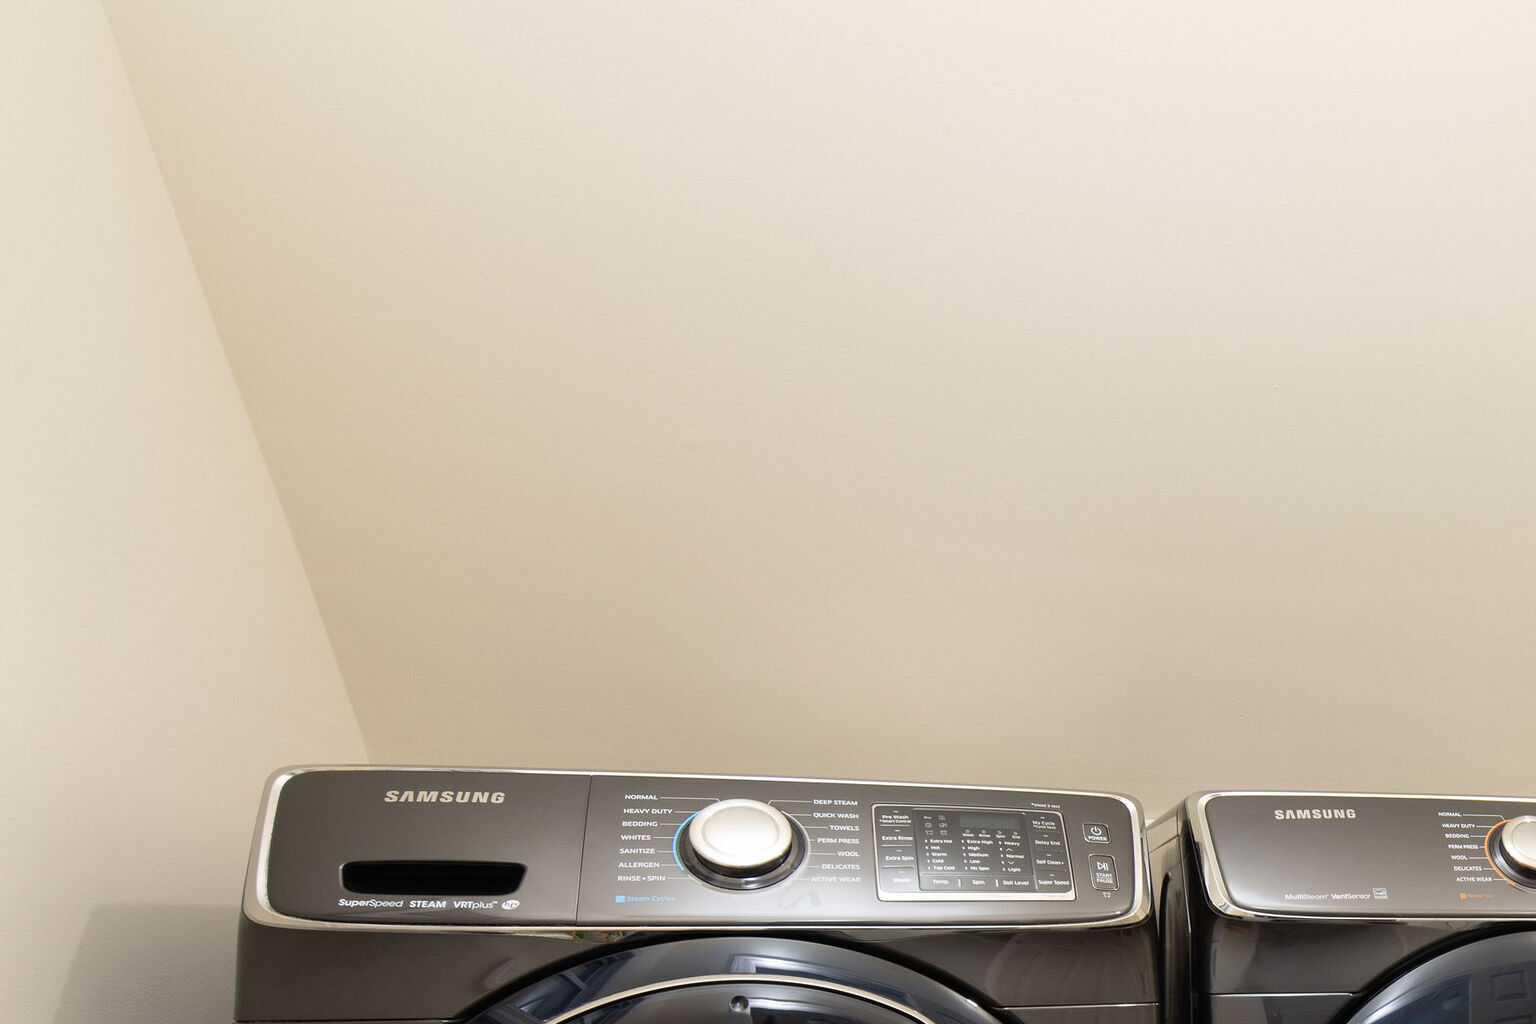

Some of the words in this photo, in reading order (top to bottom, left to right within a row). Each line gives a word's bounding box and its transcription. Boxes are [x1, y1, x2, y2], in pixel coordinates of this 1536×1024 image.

[384, 790, 506, 804] SAMSUNG
[1274, 808, 1357, 820] SAMSUNG
[338, 899, 403, 909] SuperSpeed
[409, 900, 446, 908] STEAM
